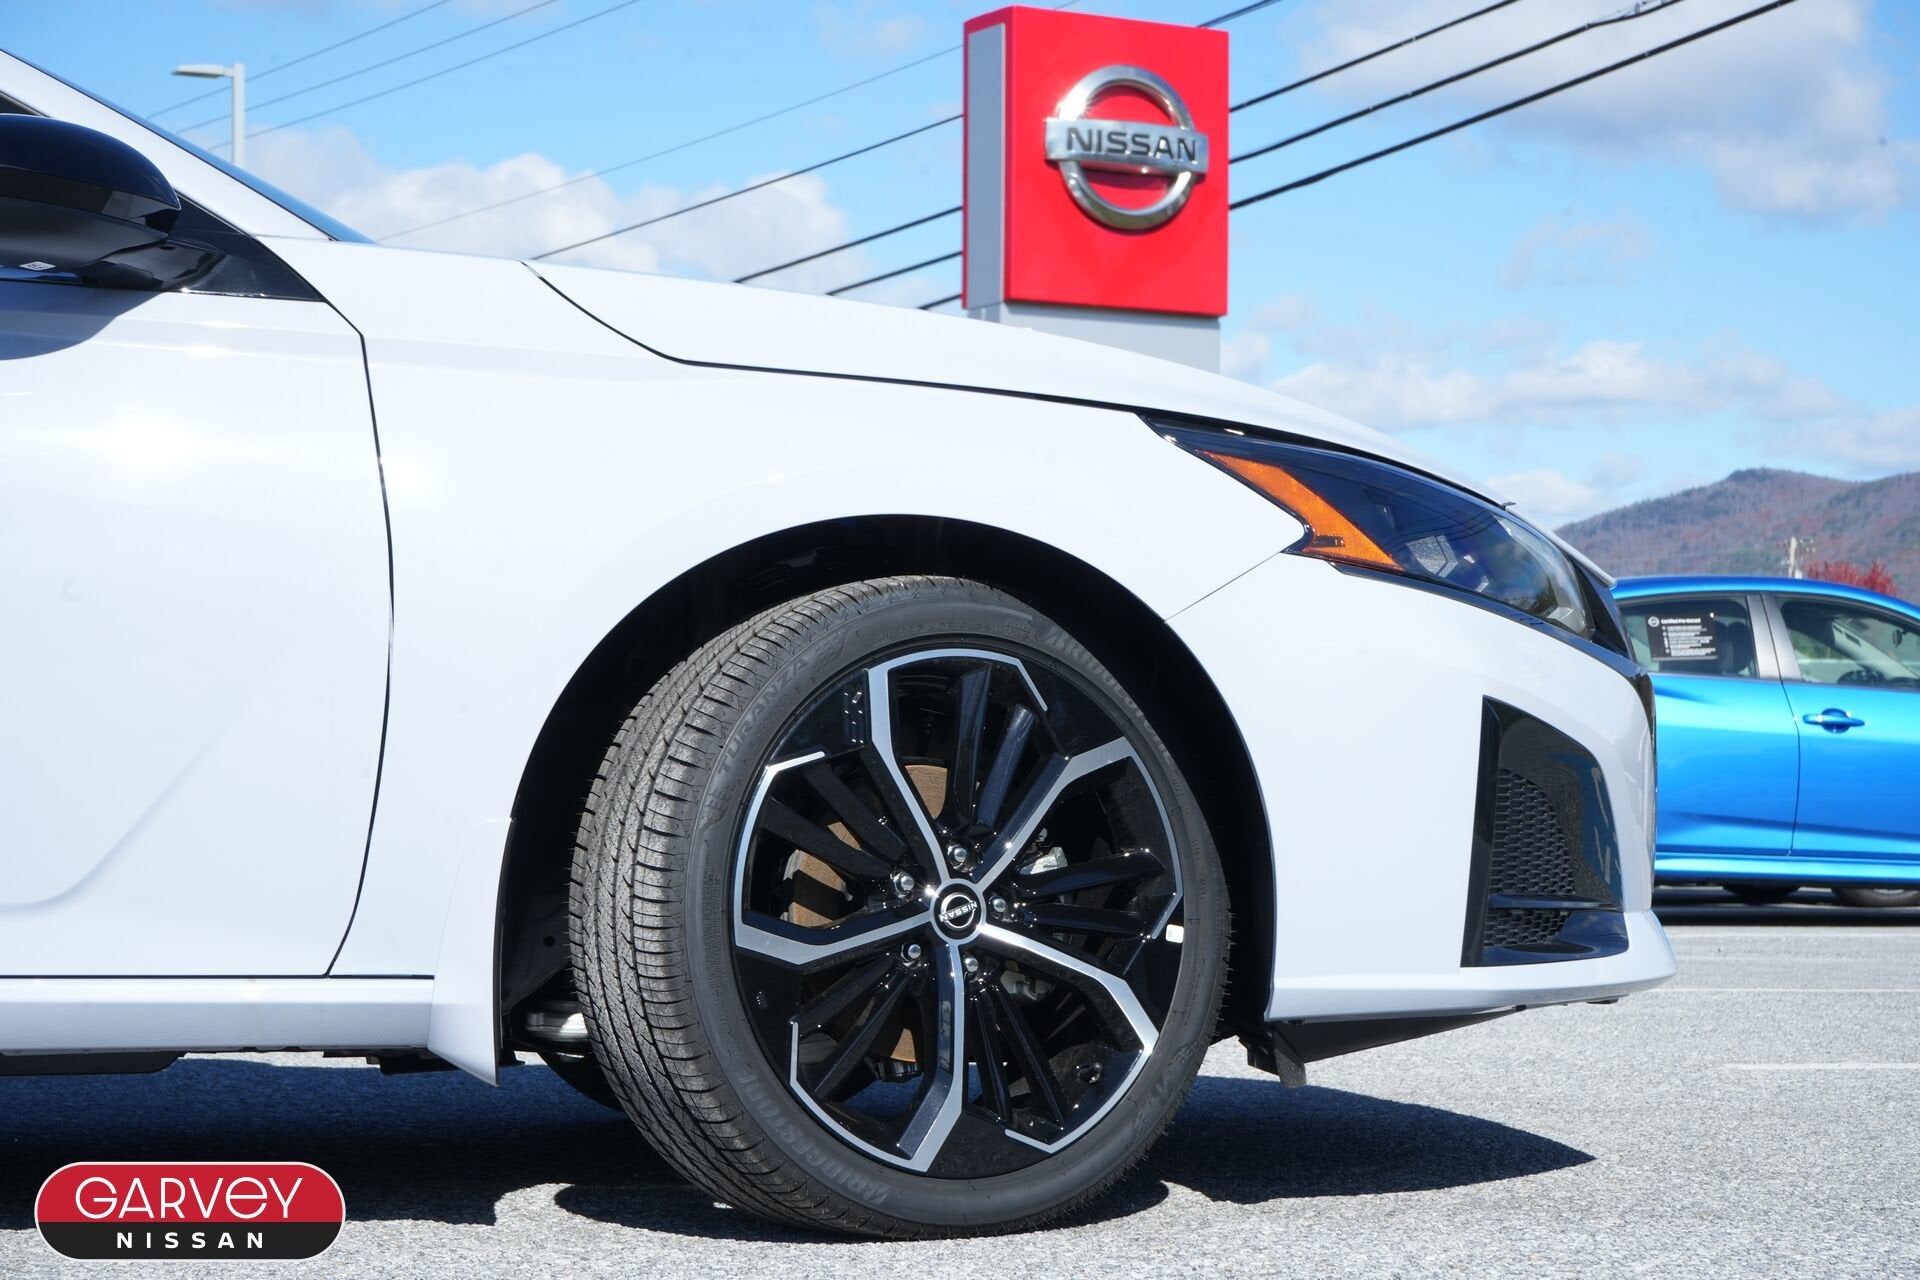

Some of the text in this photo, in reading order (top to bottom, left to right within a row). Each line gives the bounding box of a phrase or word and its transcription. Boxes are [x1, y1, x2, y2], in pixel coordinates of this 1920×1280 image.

[1066, 127, 1197, 162] NISSAN
[717, 655, 809, 776] TURANZA
[939, 900, 978, 922] NISSAN
